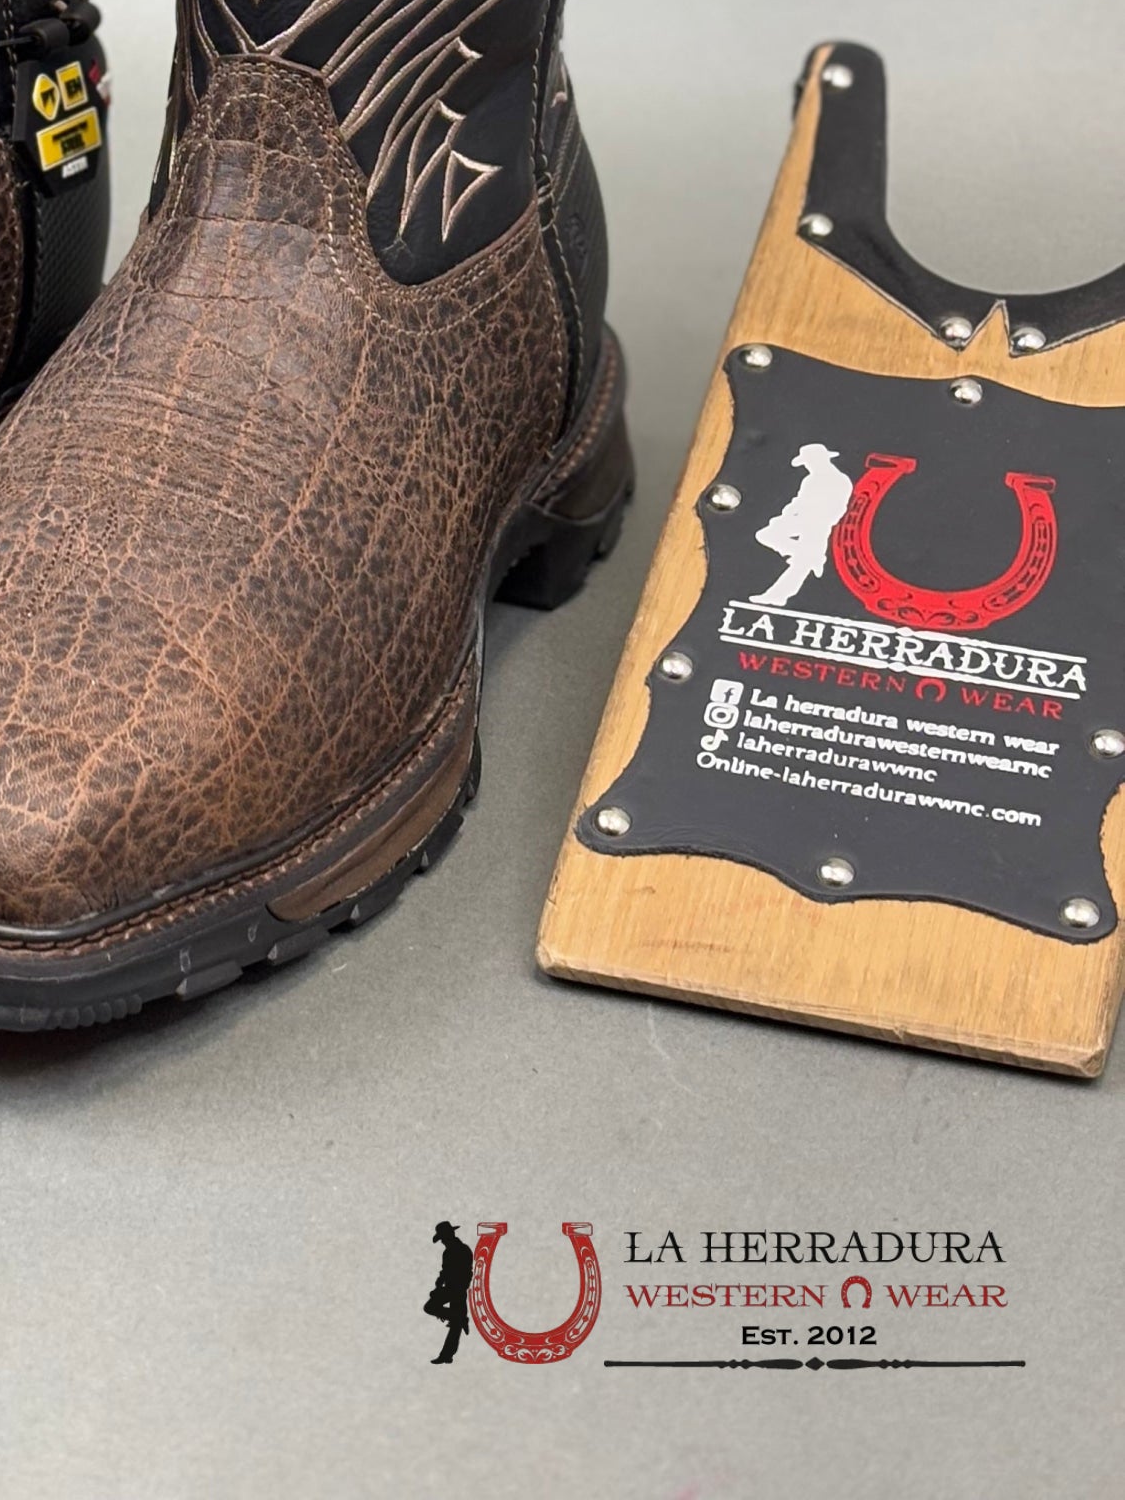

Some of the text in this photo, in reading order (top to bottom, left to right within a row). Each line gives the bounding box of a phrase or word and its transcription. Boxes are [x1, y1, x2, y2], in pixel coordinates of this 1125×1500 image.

[718, 607, 1087, 692] LA HERRADURA
[738, 651, 1064, 720] WESTERN WEAR
[750, 688, 1060, 756] La herradura western wear
[696, 751, 1042, 827] Online-laherradurawwnc.com
[736, 731, 938, 783] laherradurawwnc
